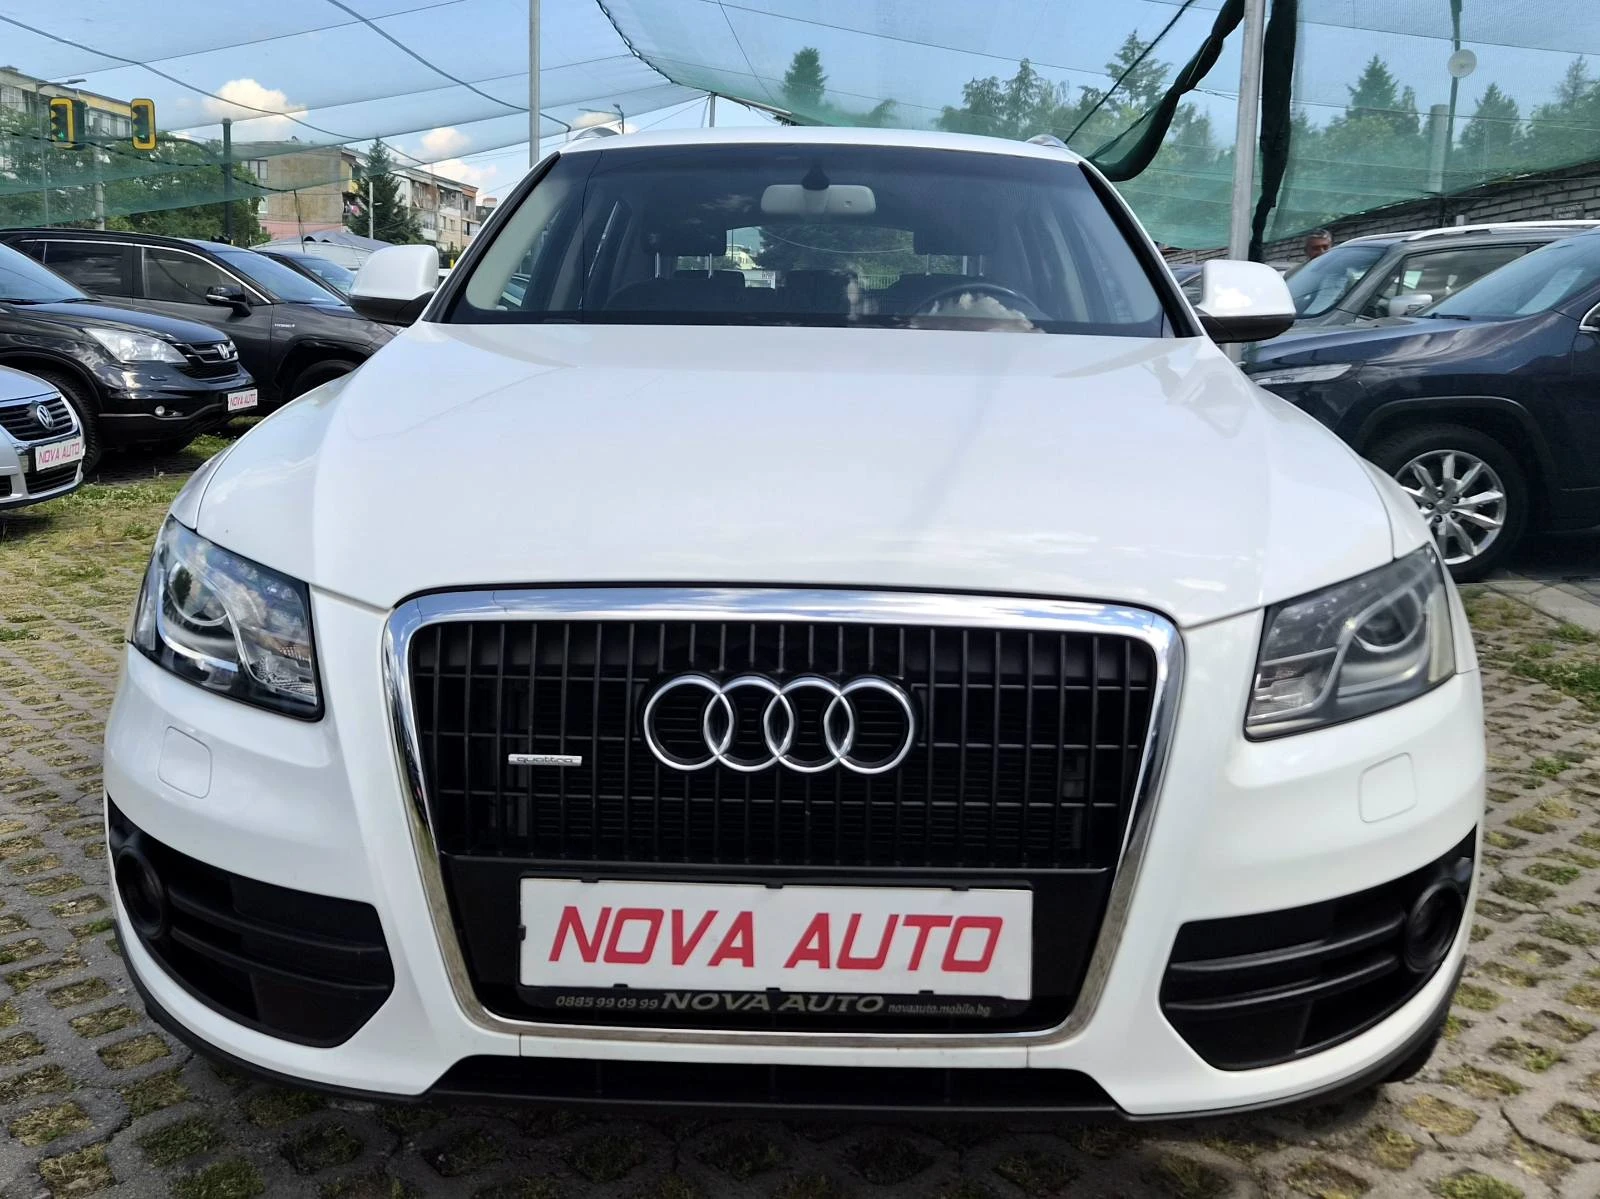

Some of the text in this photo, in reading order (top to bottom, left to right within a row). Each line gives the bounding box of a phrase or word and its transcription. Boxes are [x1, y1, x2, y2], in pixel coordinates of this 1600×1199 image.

[39, 442, 80, 464] NOVA AUTO
[549, 906, 1003, 973] NOVA AUTO
[555, 991, 991, 1017] 0885 99 09 99 NOVA AUTO novaauto.mobile.bg
